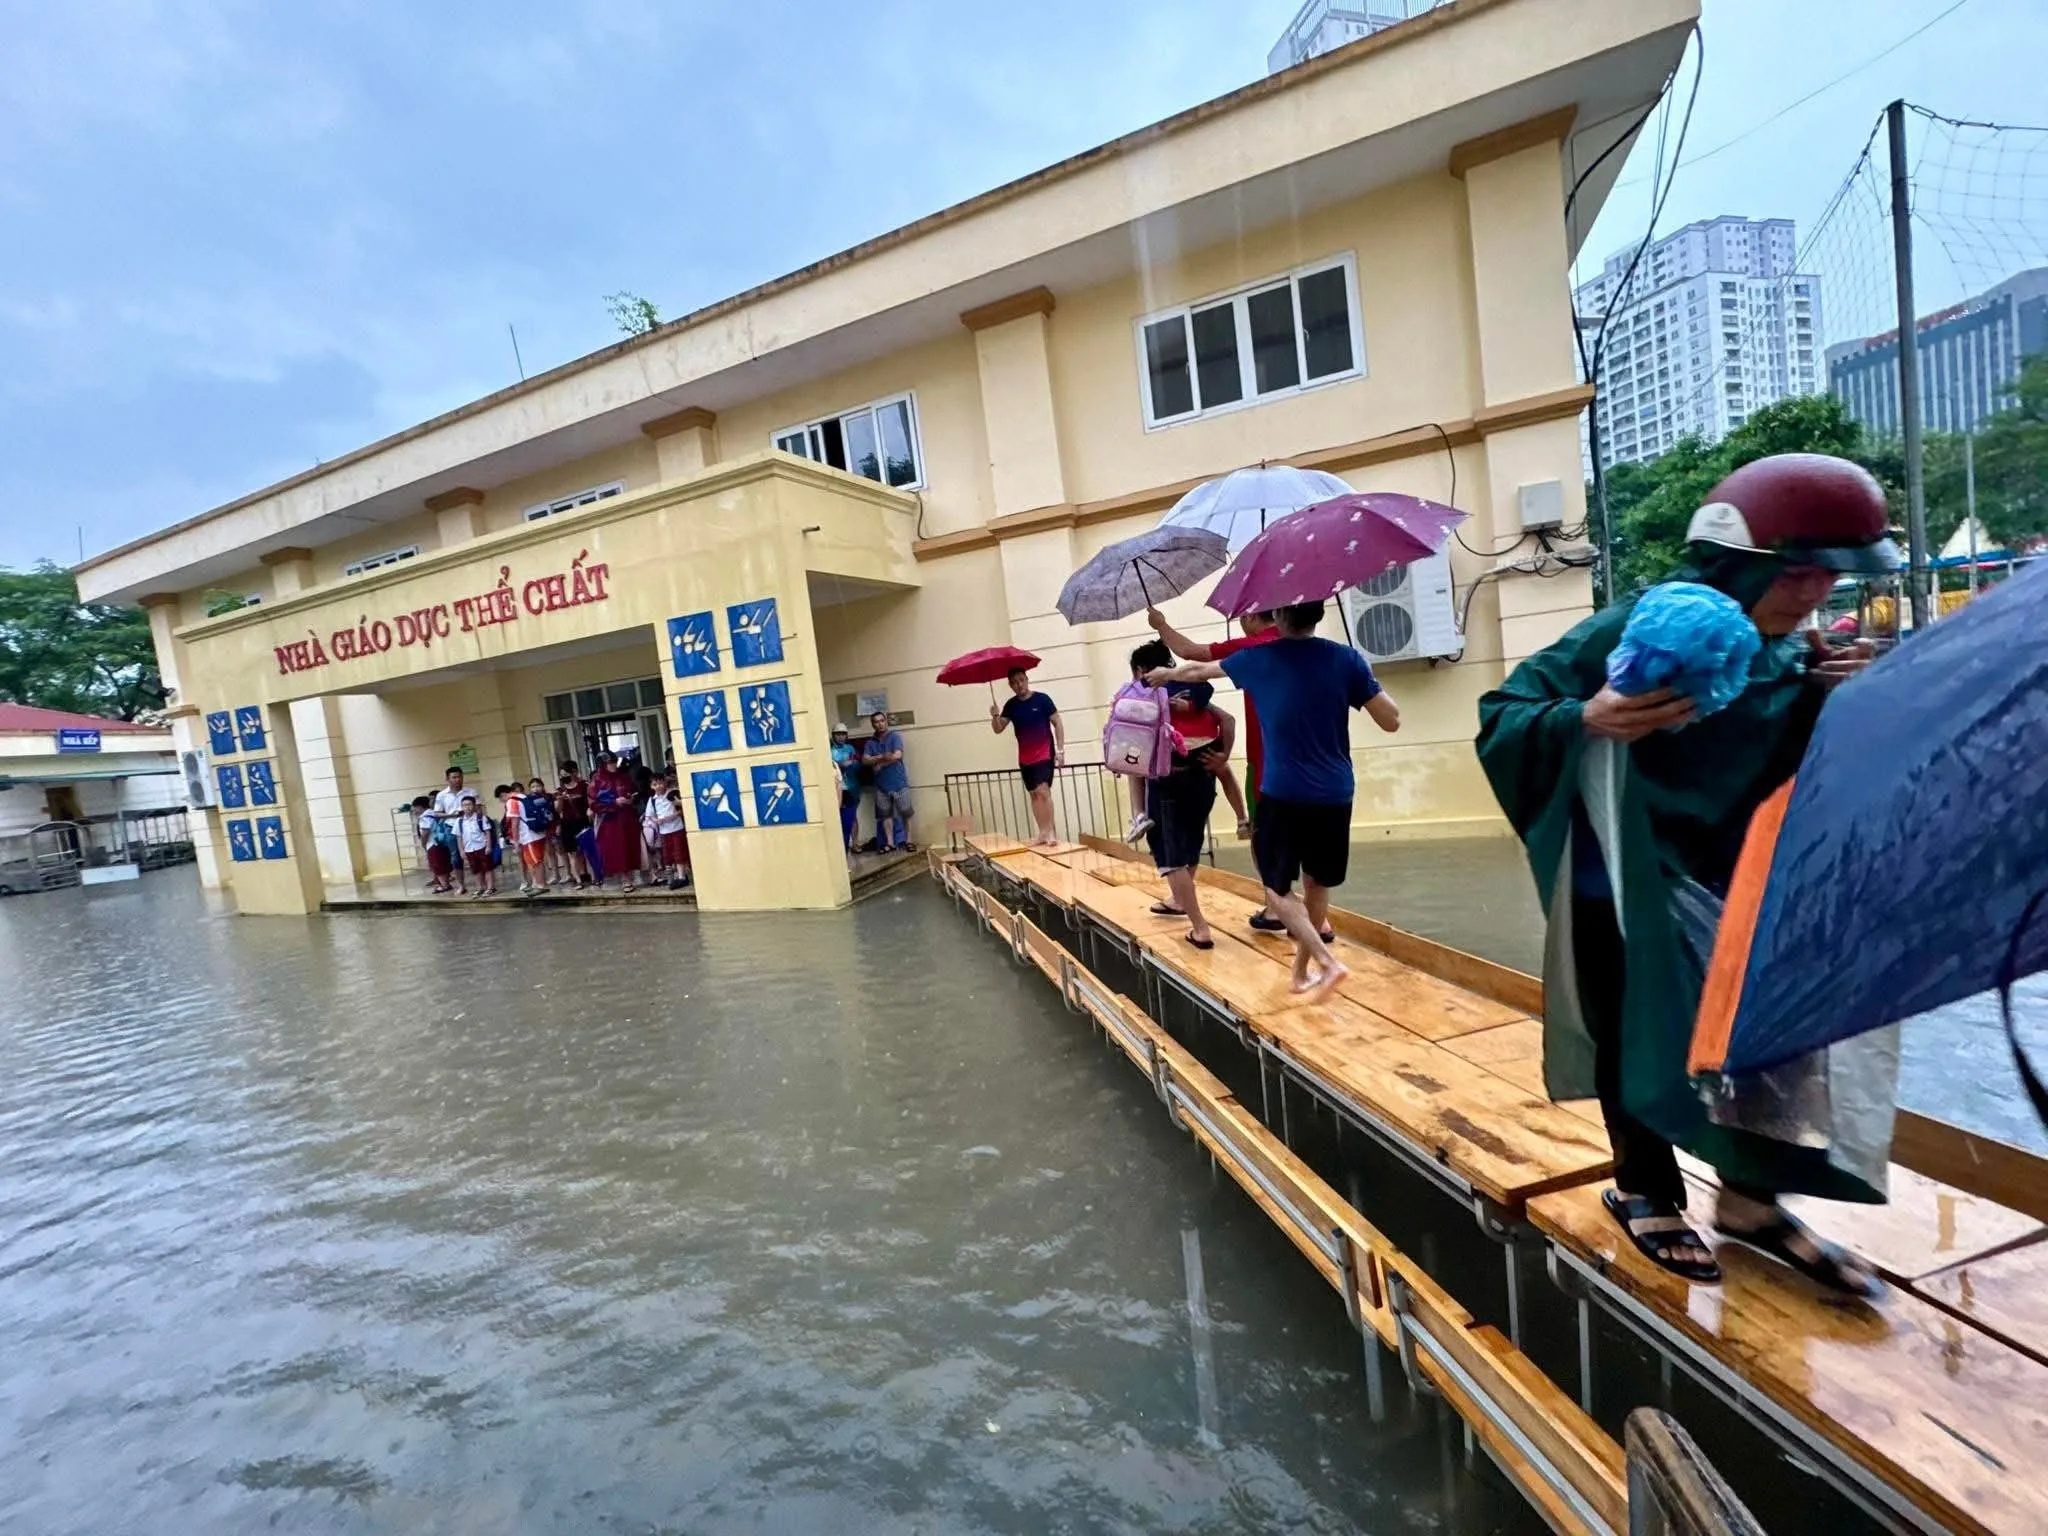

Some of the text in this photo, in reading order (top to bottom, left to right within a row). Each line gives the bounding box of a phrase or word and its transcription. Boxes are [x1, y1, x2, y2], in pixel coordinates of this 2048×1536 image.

[274, 549, 610, 675] NHÀ GIÁO DỤC THỂ CHẤT
